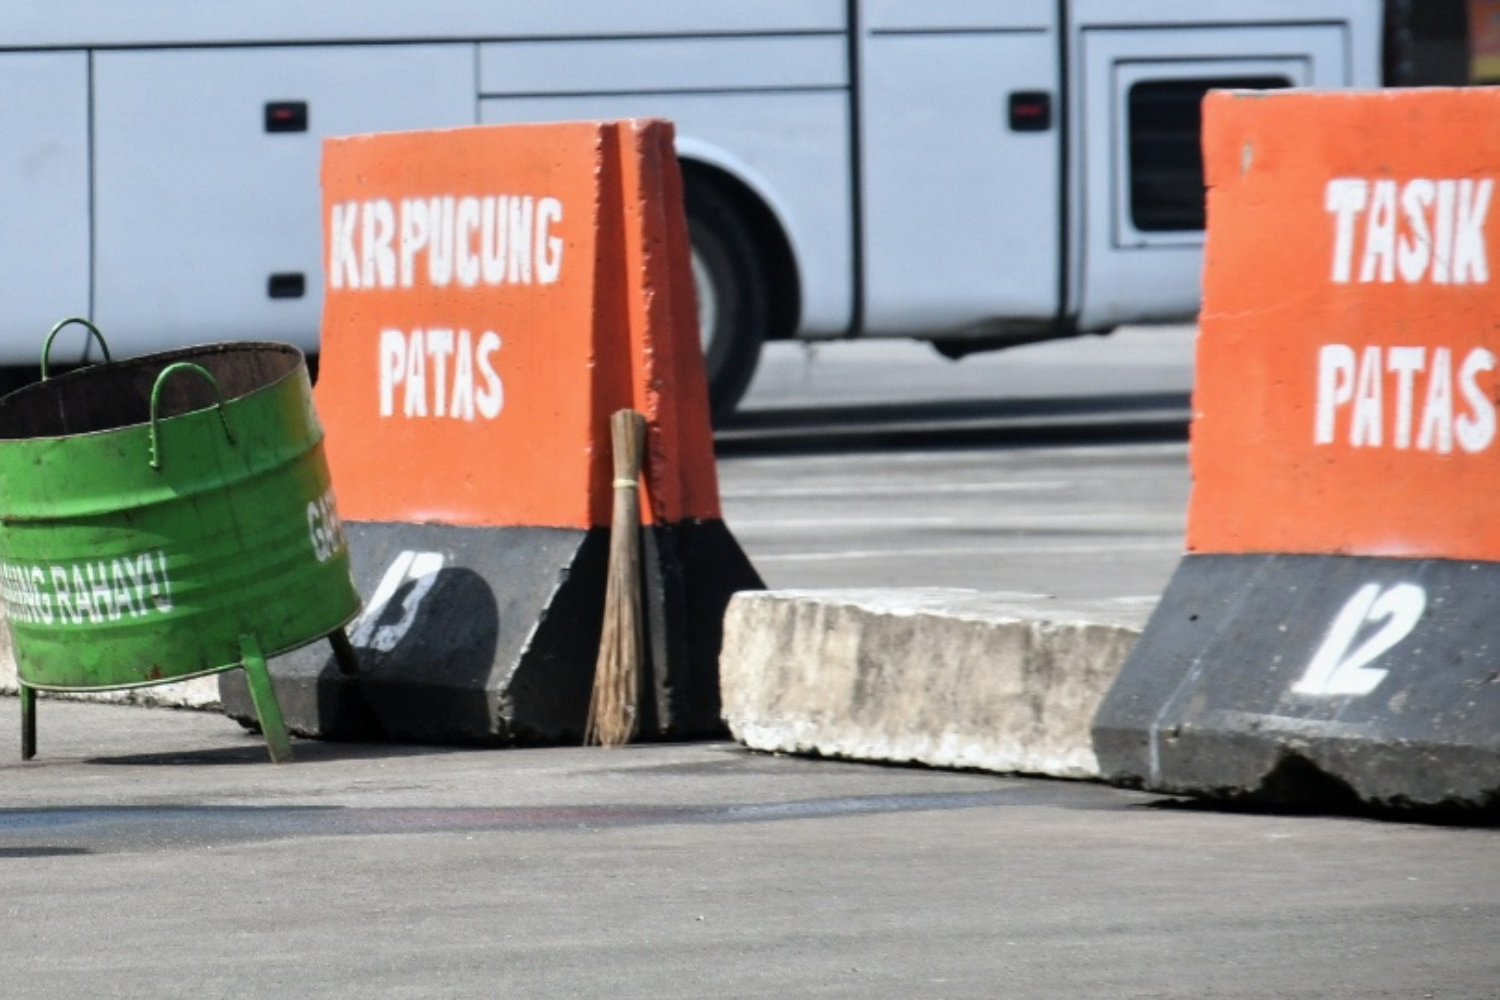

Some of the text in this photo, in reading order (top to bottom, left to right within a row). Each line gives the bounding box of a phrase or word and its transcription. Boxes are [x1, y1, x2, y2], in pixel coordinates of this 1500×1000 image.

[1326, 178, 1494, 284] TASIK
[379, 328, 504, 420] PATAS
[1314, 345, 1497, 454] PATAS
[50, 550, 173, 625] RAHAYU
[345, 550, 444, 652] 13
[1290, 582, 1427, 696] 12
